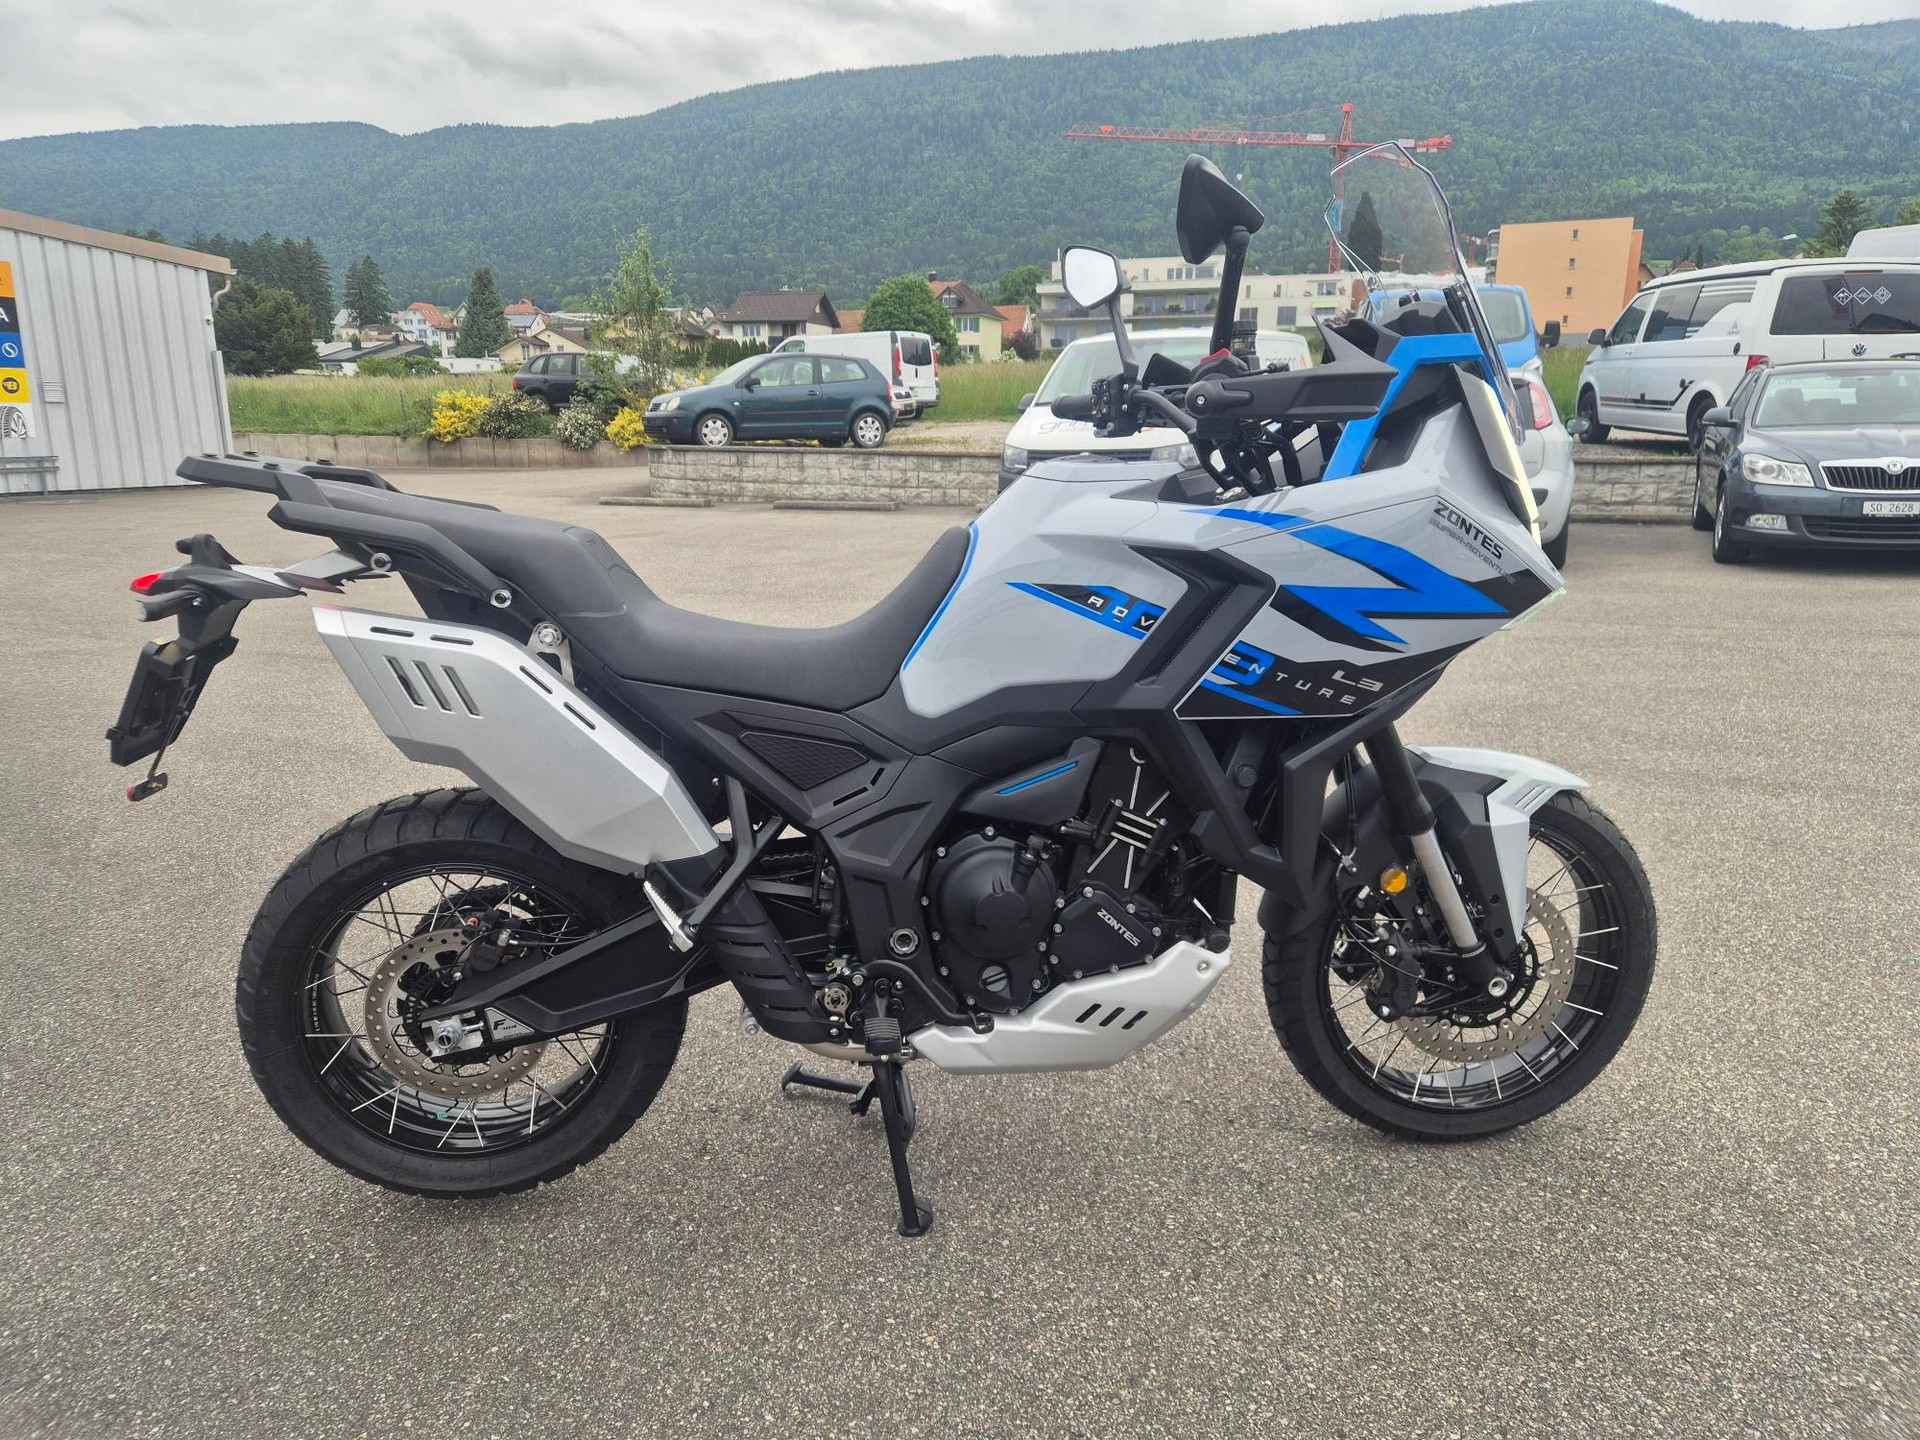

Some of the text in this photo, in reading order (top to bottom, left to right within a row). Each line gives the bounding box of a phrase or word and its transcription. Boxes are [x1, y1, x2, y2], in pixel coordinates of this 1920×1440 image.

[1870, 503, 1914, 512] SO 2628
[1433, 501, 1504, 560] ZONTES
[1331, 669, 1385, 692] L3
[1097, 908, 1140, 946] ZONTES
